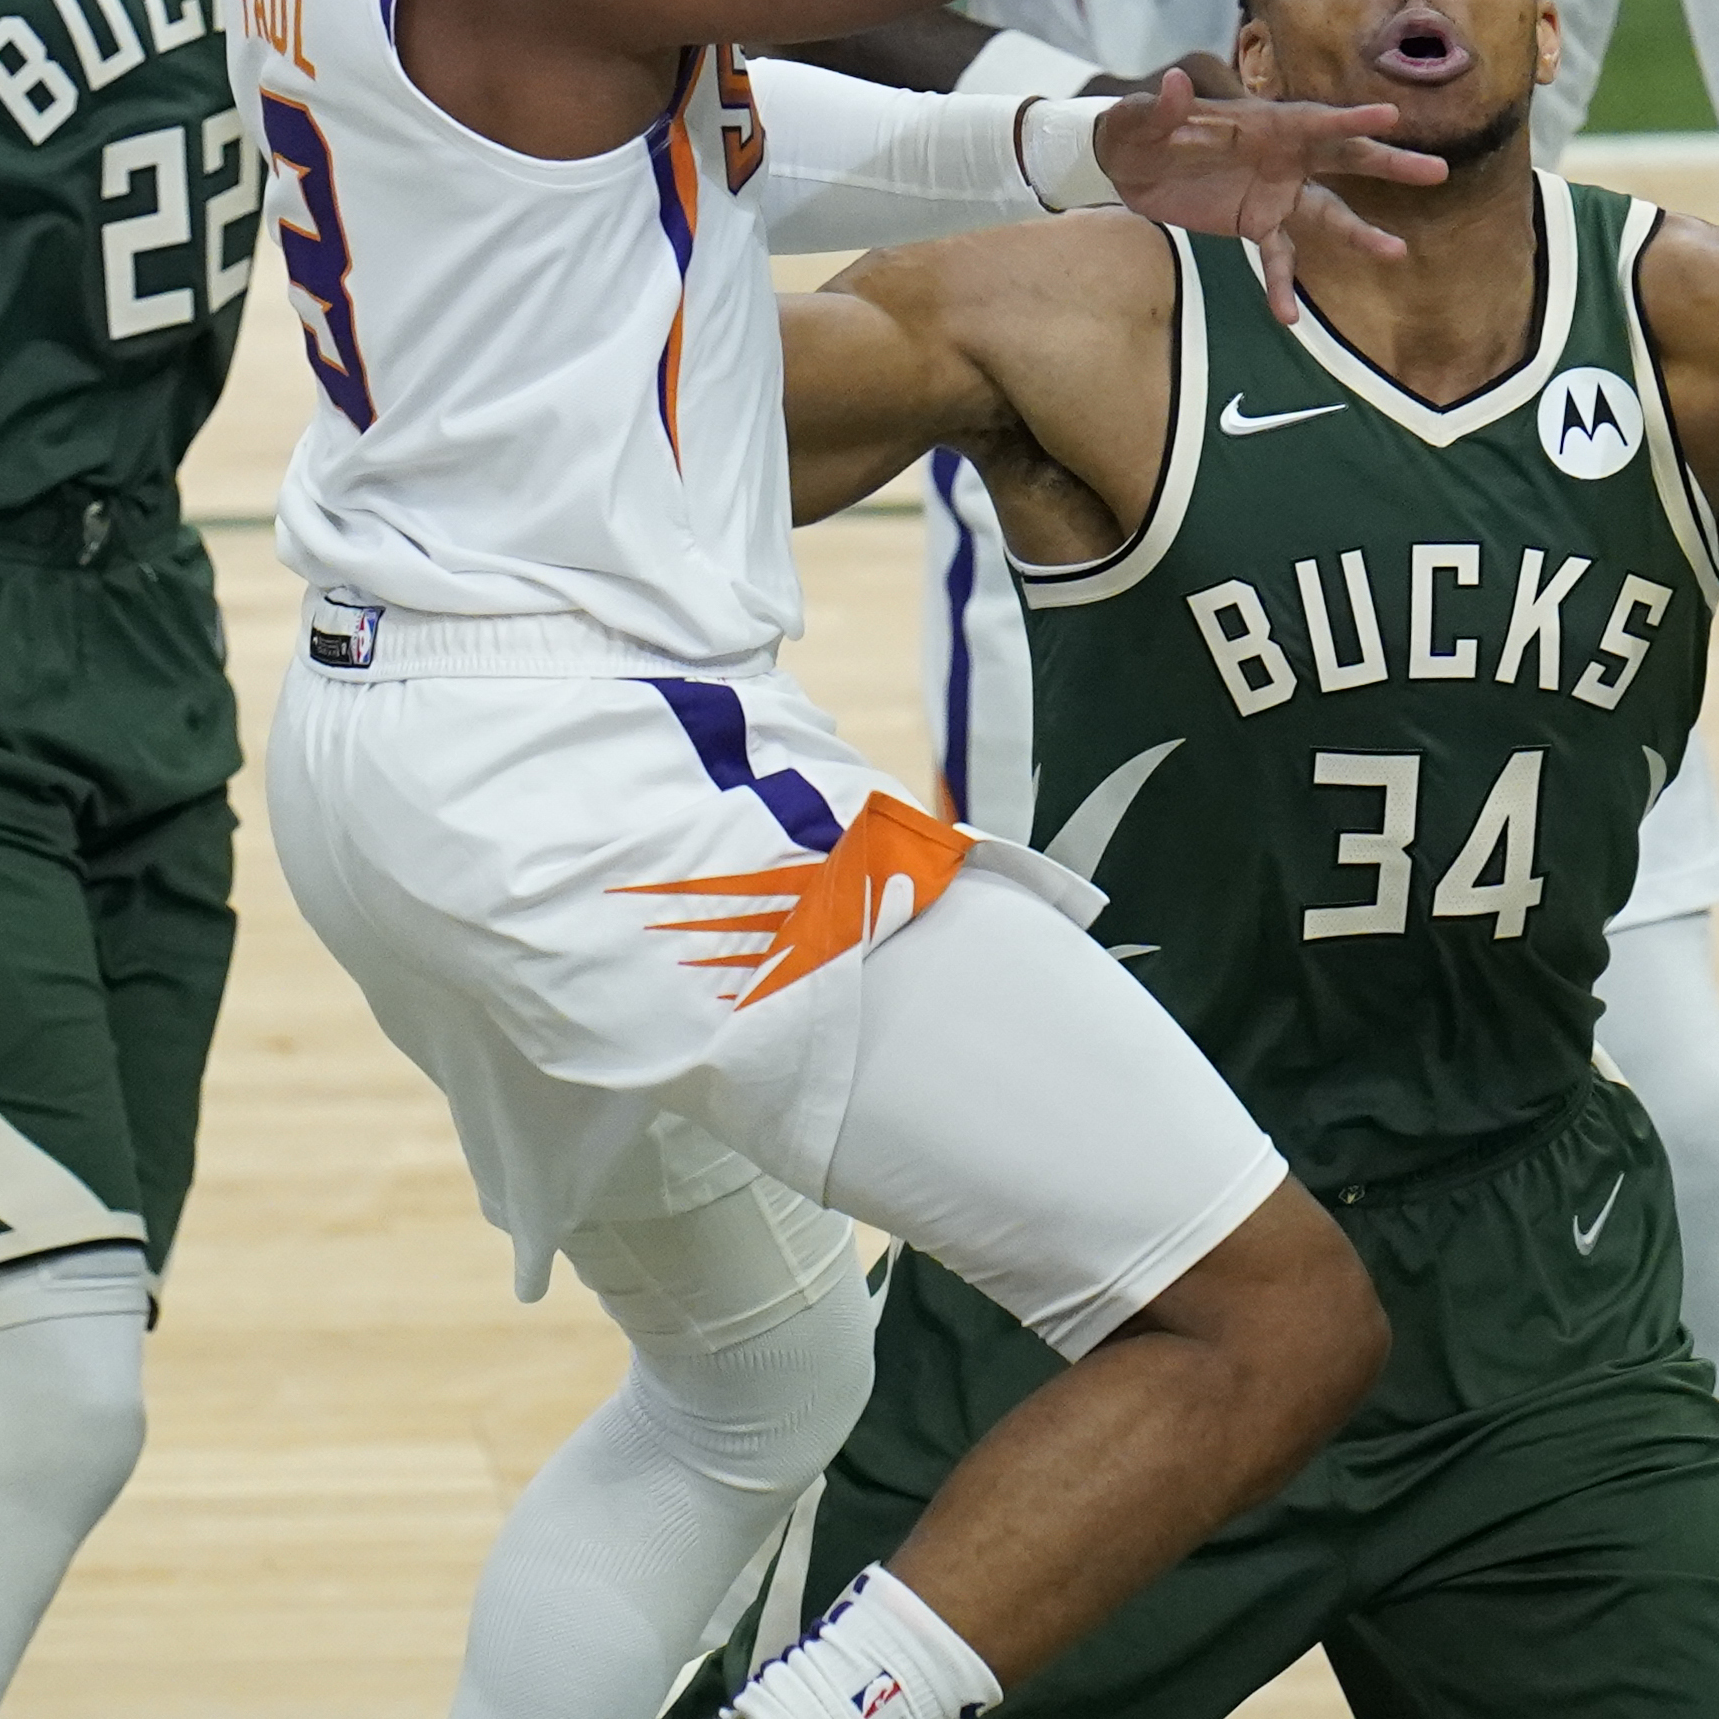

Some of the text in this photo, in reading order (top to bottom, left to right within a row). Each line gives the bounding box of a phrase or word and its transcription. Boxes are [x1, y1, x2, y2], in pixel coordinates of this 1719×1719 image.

[101, 109, 260, 341] 22
[1184, 542, 1674, 718] BUCKS
[1302, 747, 1548, 942] 34
